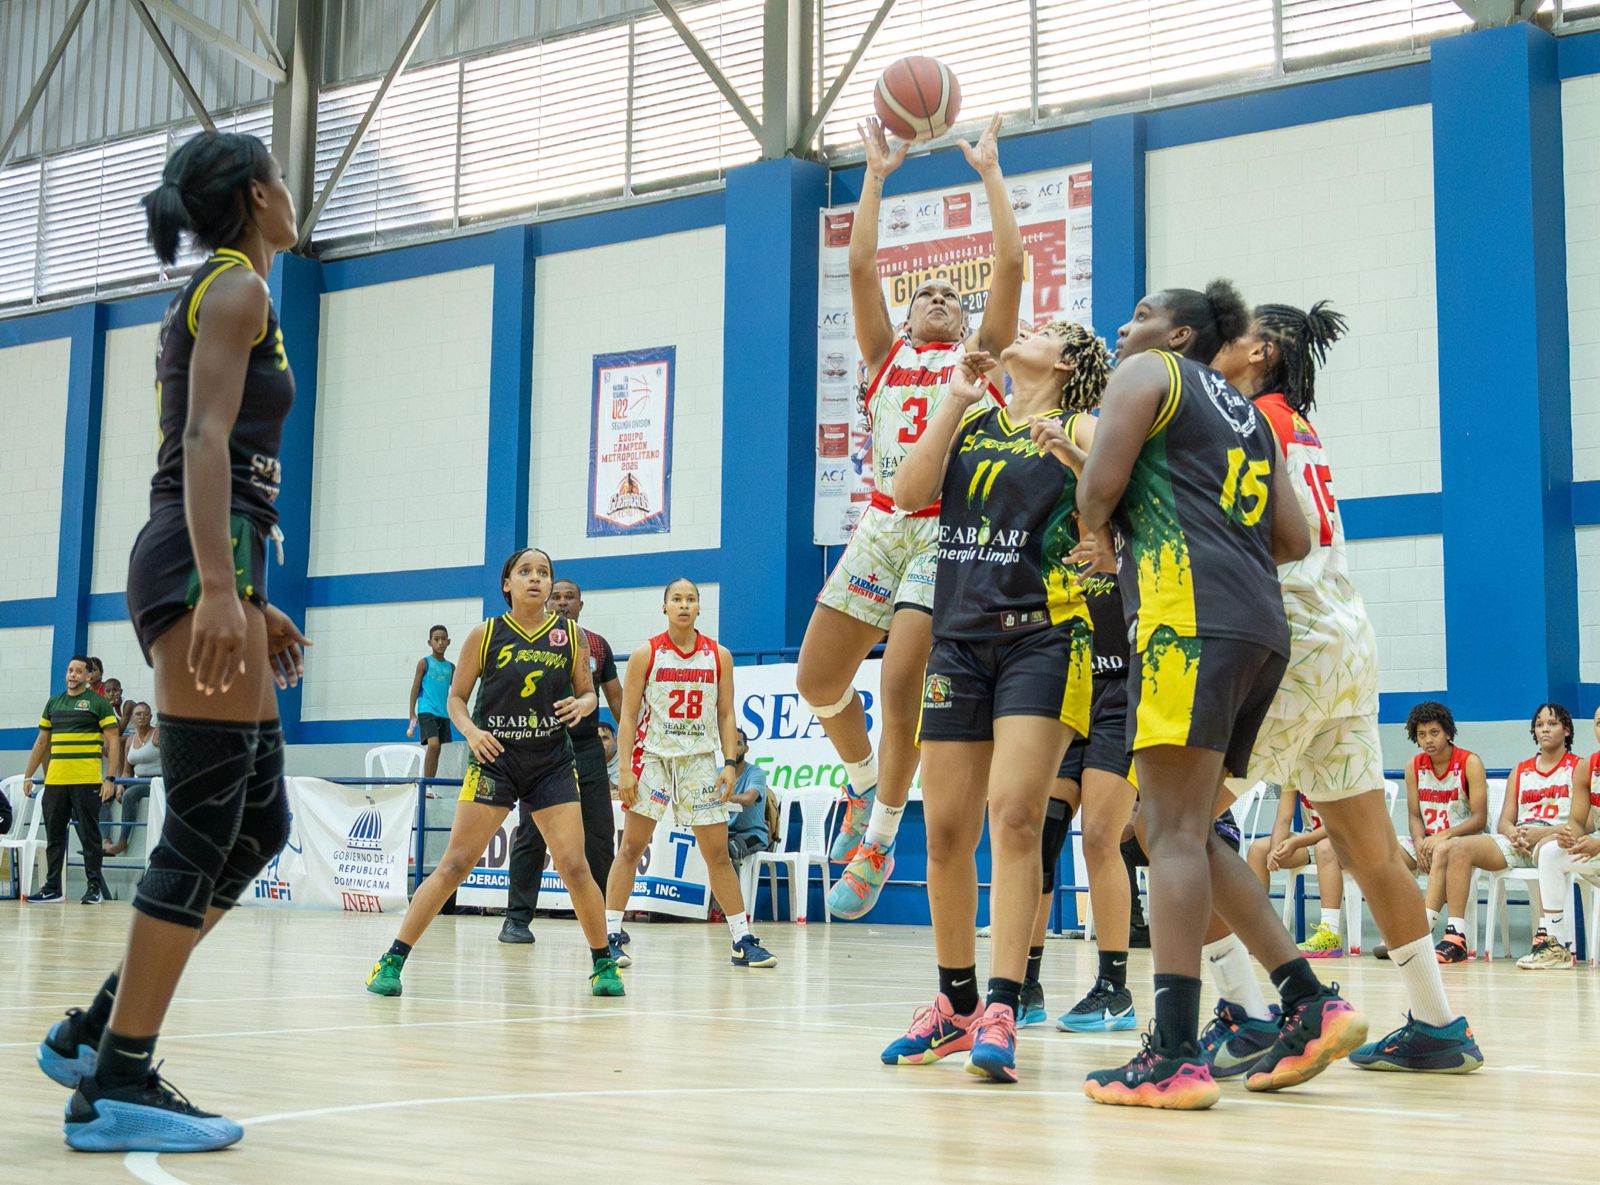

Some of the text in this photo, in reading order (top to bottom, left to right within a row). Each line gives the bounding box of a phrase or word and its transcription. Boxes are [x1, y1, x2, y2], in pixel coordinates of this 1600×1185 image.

[1039, 183, 1063, 198] ACT
[916, 203, 941, 217] ACT
[823, 312, 849, 325] ACT
[612, 399, 628, 420] U22
[898, 396, 927, 443] 3
[618, 431, 643, 443] EQUIPO
[613, 441, 648, 453] CAMPEON
[601, 450, 660, 463] METROPOLITANO
[821, 468, 847, 482] ACT
[968, 459, 1007, 508] 11
[1219, 446, 1271, 527] 15
[850, 575, 893, 599] FARMACIA
[496, 643, 519, 669] 5
[669, 689, 704, 719] 28
[1424, 808, 1450, 836] 23
[333, 850, 394, 864] GOBIERNO DE LA
[338, 864, 388, 876] REPUBLICA
[334, 876, 391, 890] DOMINICANA
[655, 885, 681, 898] INC.
[341, 892, 385, 913] INEFI
